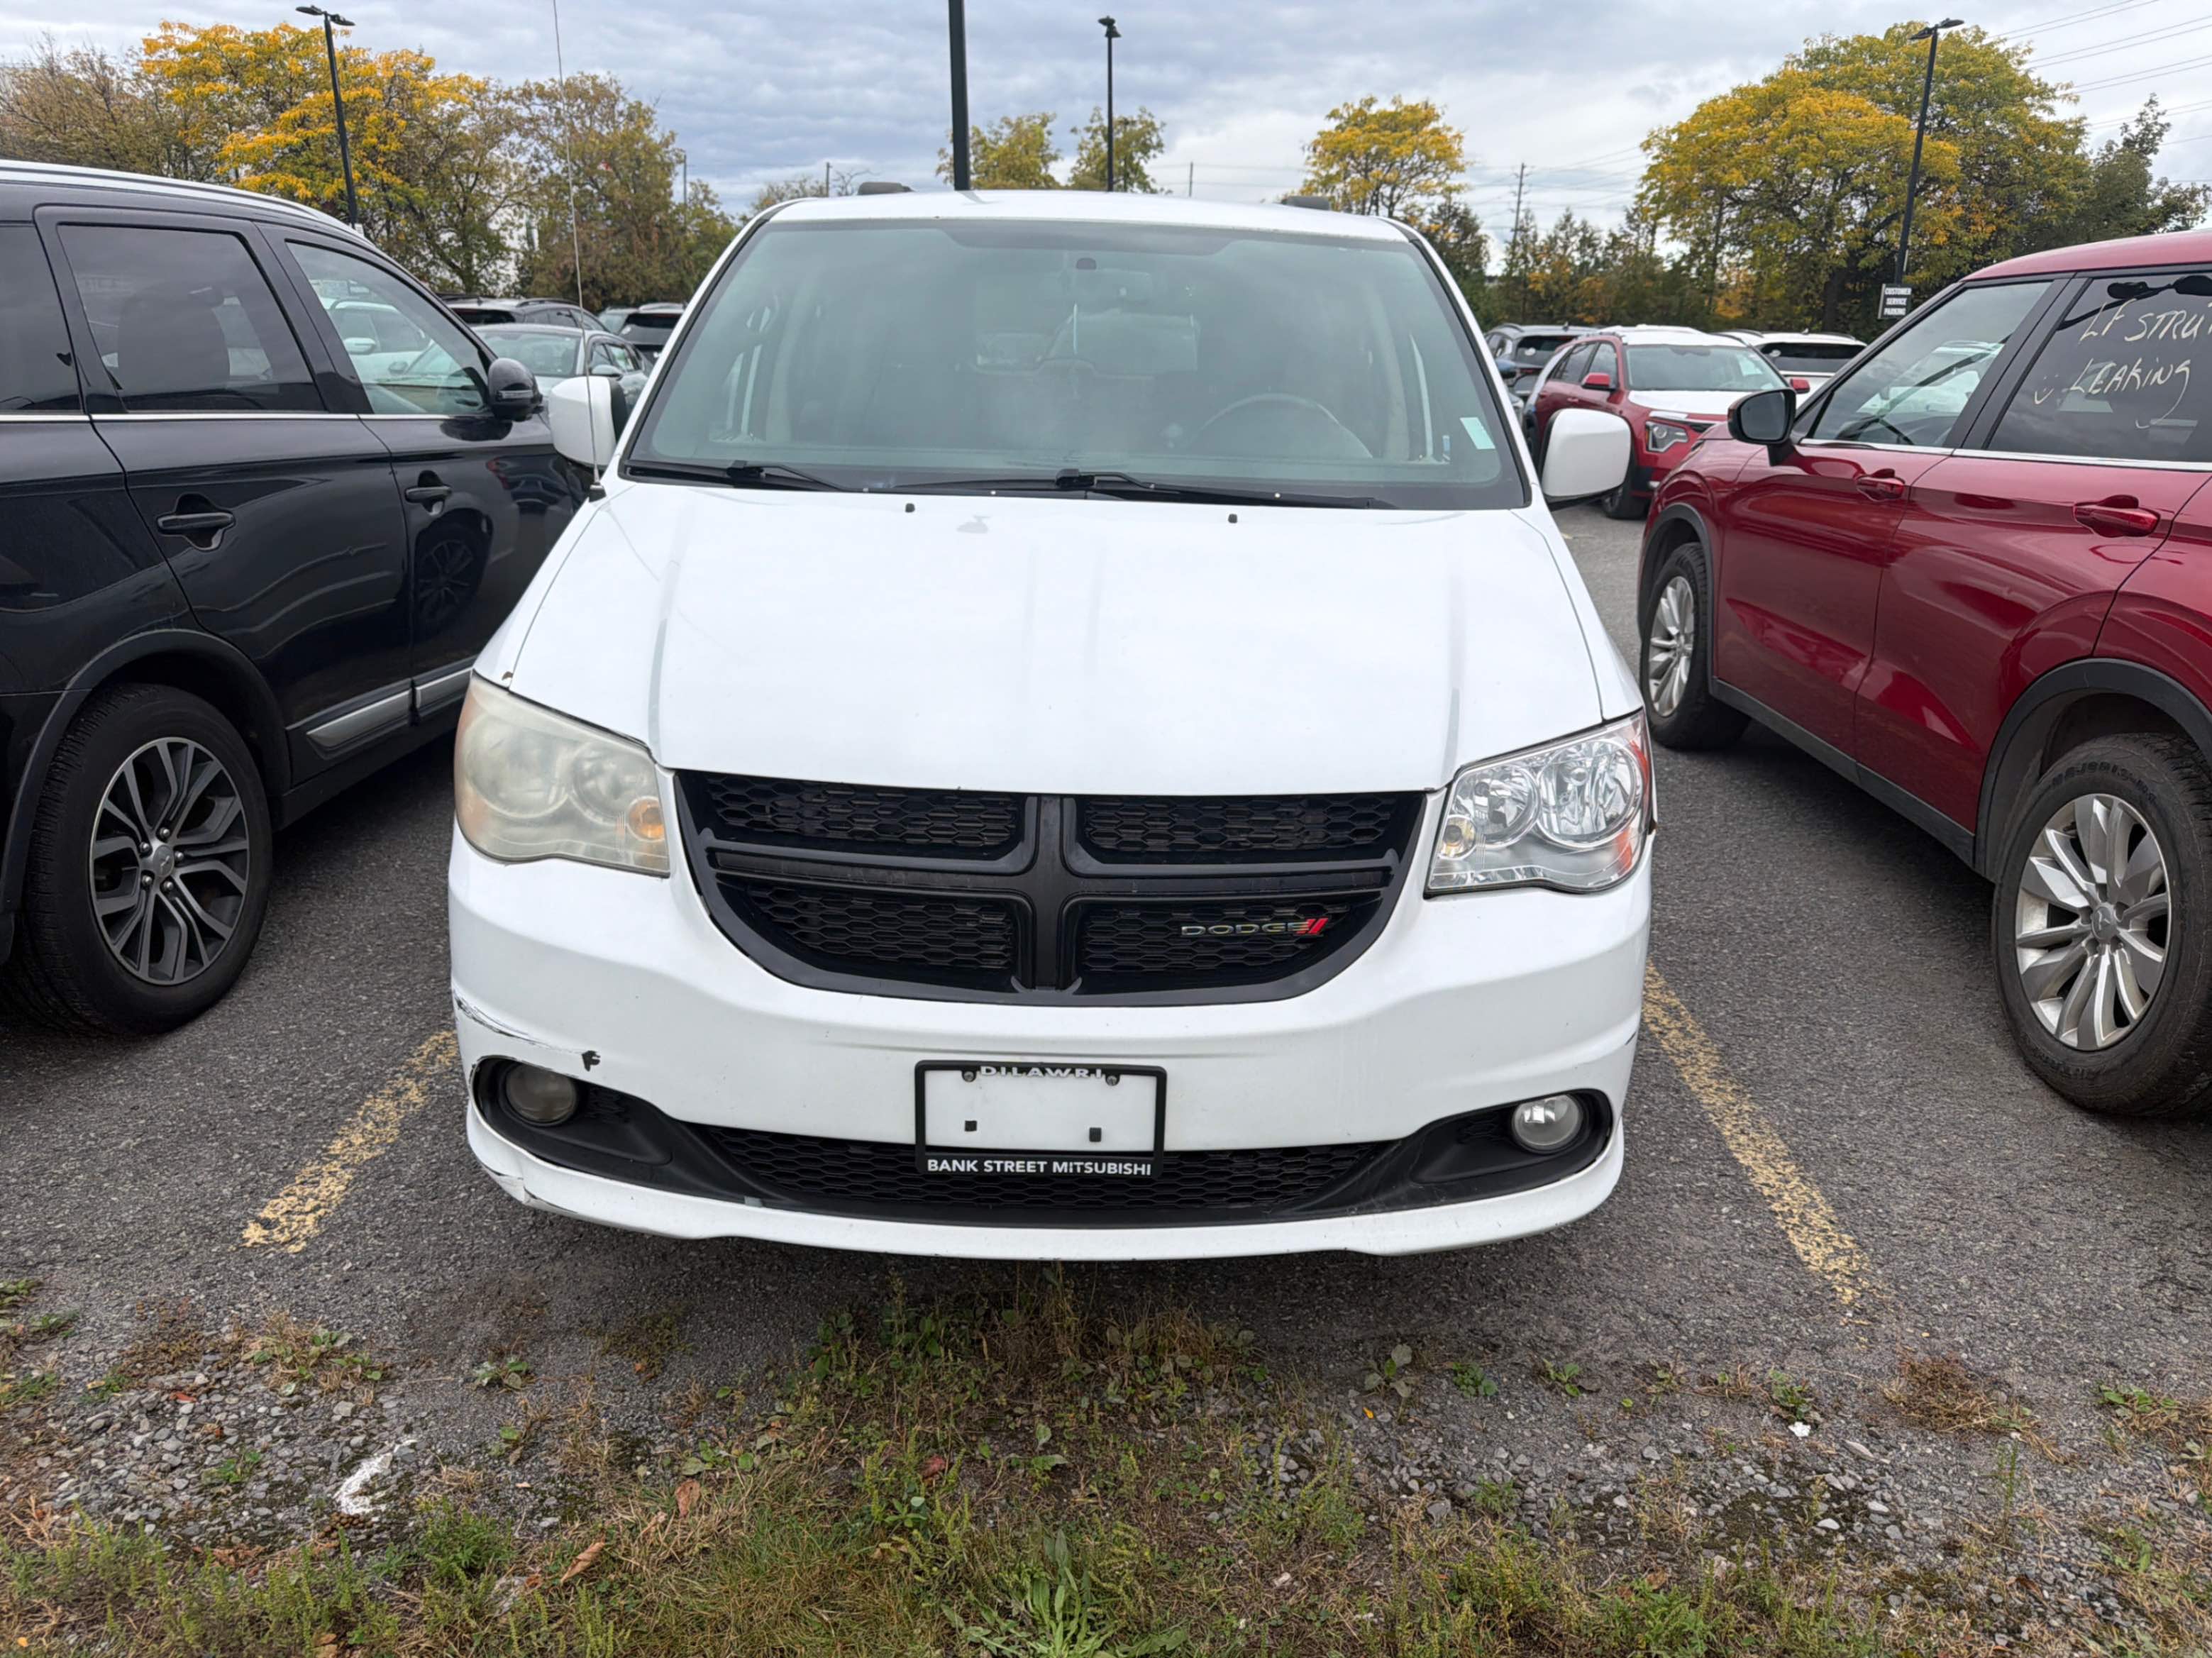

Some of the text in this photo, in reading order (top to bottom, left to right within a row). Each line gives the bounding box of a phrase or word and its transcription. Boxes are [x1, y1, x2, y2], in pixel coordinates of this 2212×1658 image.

[1180, 922, 1310, 936] DODGE
[980, 1066, 1103, 1079] DILAWRI
[927, 1159, 1151, 1176] BANK STREET MITSUBISHI
